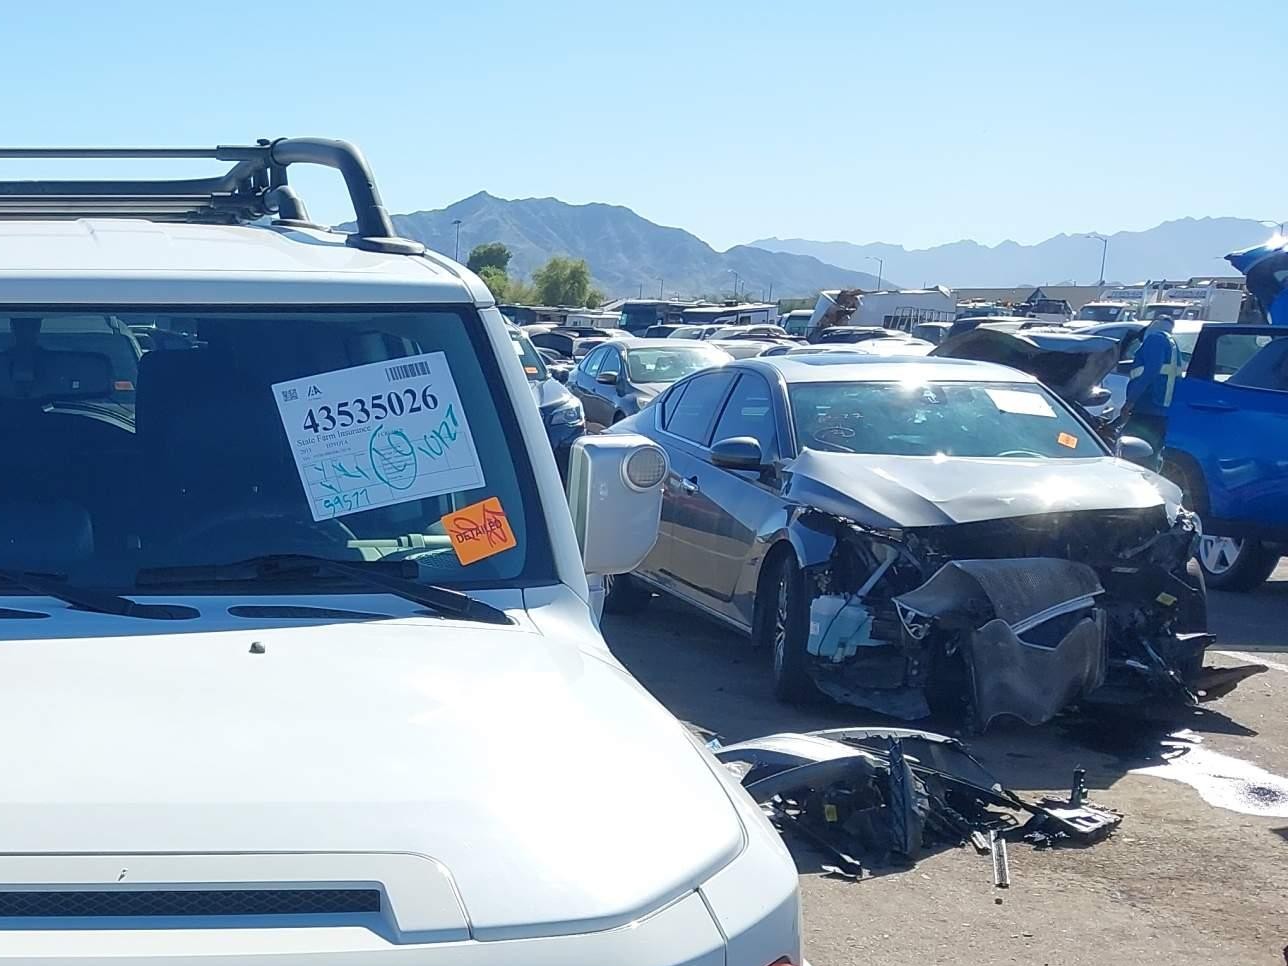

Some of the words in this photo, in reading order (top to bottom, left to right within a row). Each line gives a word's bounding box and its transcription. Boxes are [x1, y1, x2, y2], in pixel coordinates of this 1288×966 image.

[303, 384, 438, 433] 43535026
[297, 438, 315, 448] State
[317, 433, 336, 443] Farm
[338, 426, 371, 437] Insurance
[455, 519, 502, 543] DETAILED
